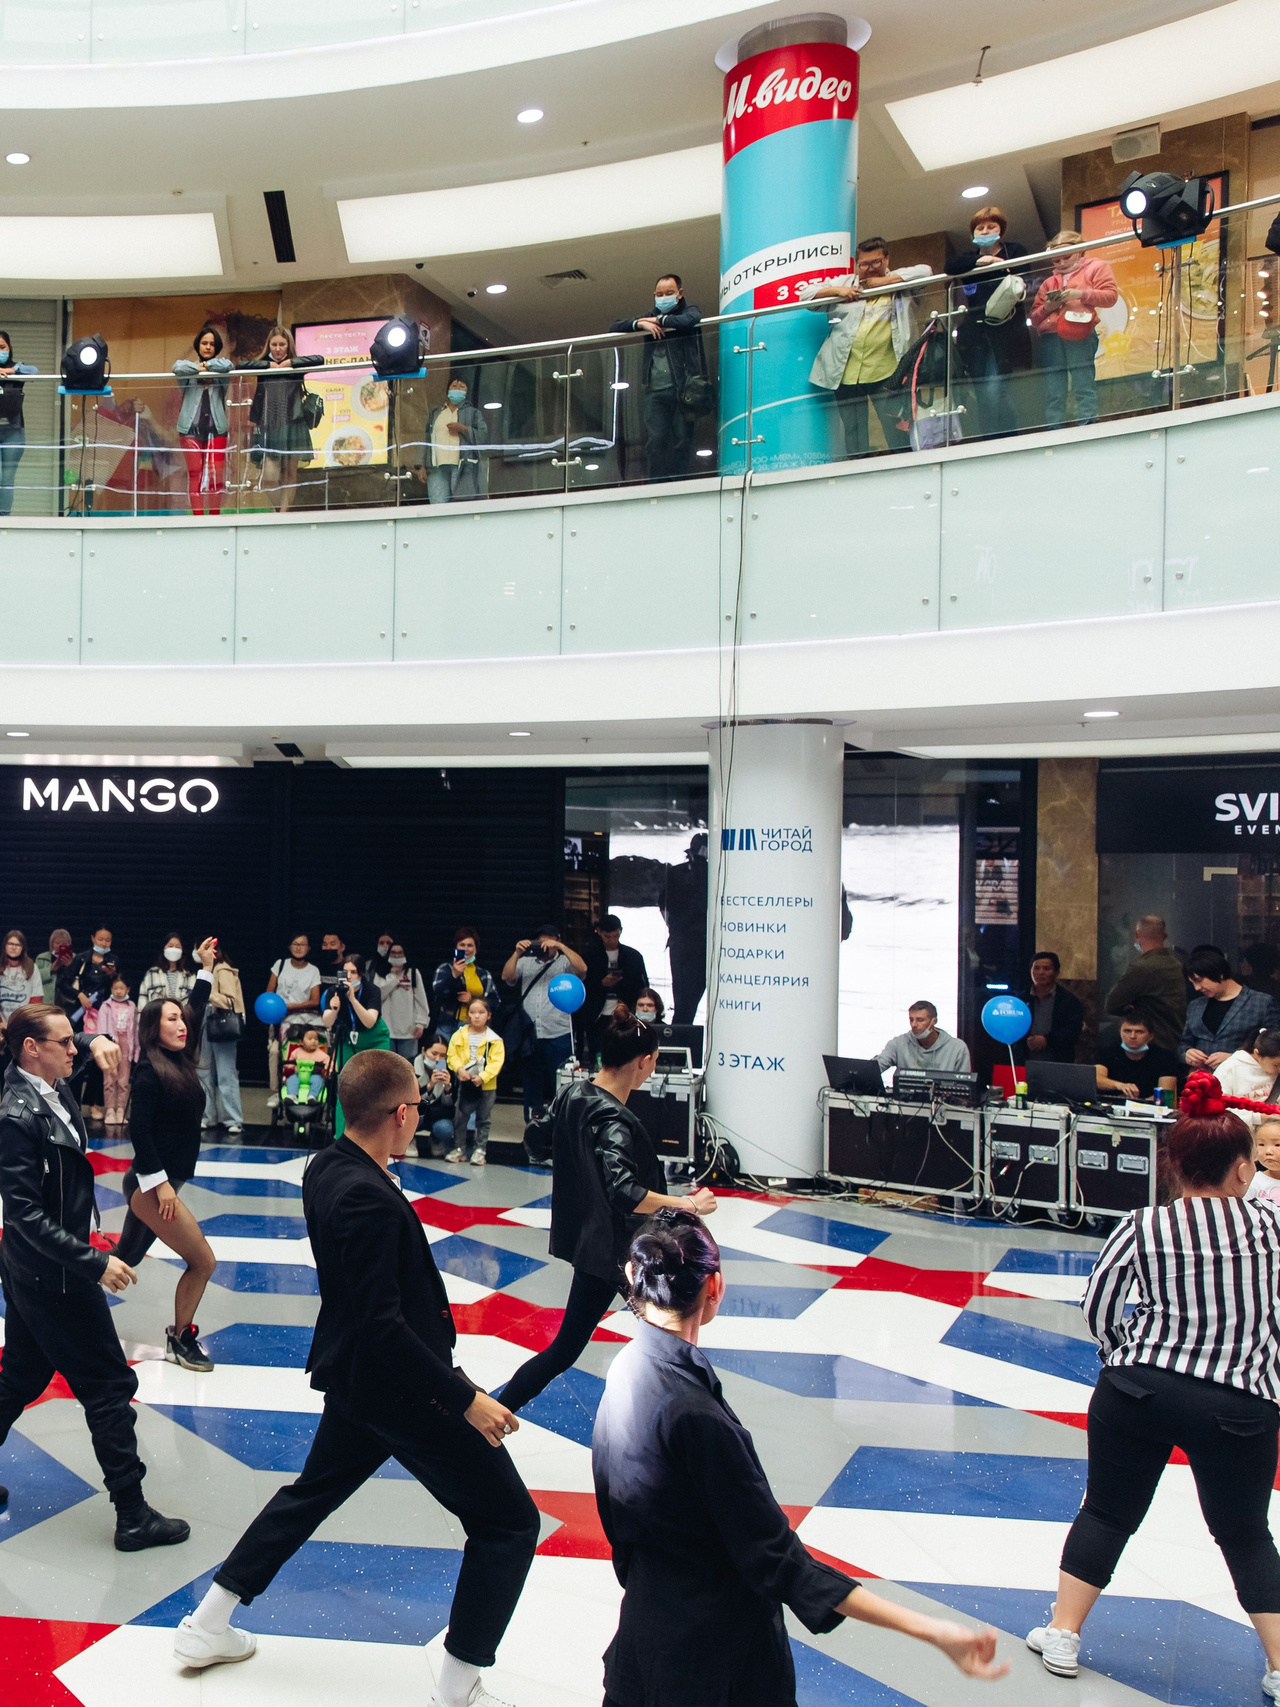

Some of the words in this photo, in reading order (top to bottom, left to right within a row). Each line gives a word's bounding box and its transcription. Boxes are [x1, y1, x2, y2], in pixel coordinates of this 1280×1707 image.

[723, 66, 852, 131] М.видео
[733, 244, 842, 286] ОТКРЫЛИСЬ!
[23, 777, 219, 813] MANGO
[1215, 792, 1280, 821] SVI
[761, 825, 812, 839] ЧИТАЙ
[1234, 825, 1280, 835] EVEN
[761, 840, 813, 853] ГОРОД
[719, 973, 810, 987] КАНЦЕЛЯРИЯ
[719, 999, 761, 1011] КНИГИ
[718, 1052, 725, 1067] 3
[729, 1053, 786, 1072] ЭТАЖ
